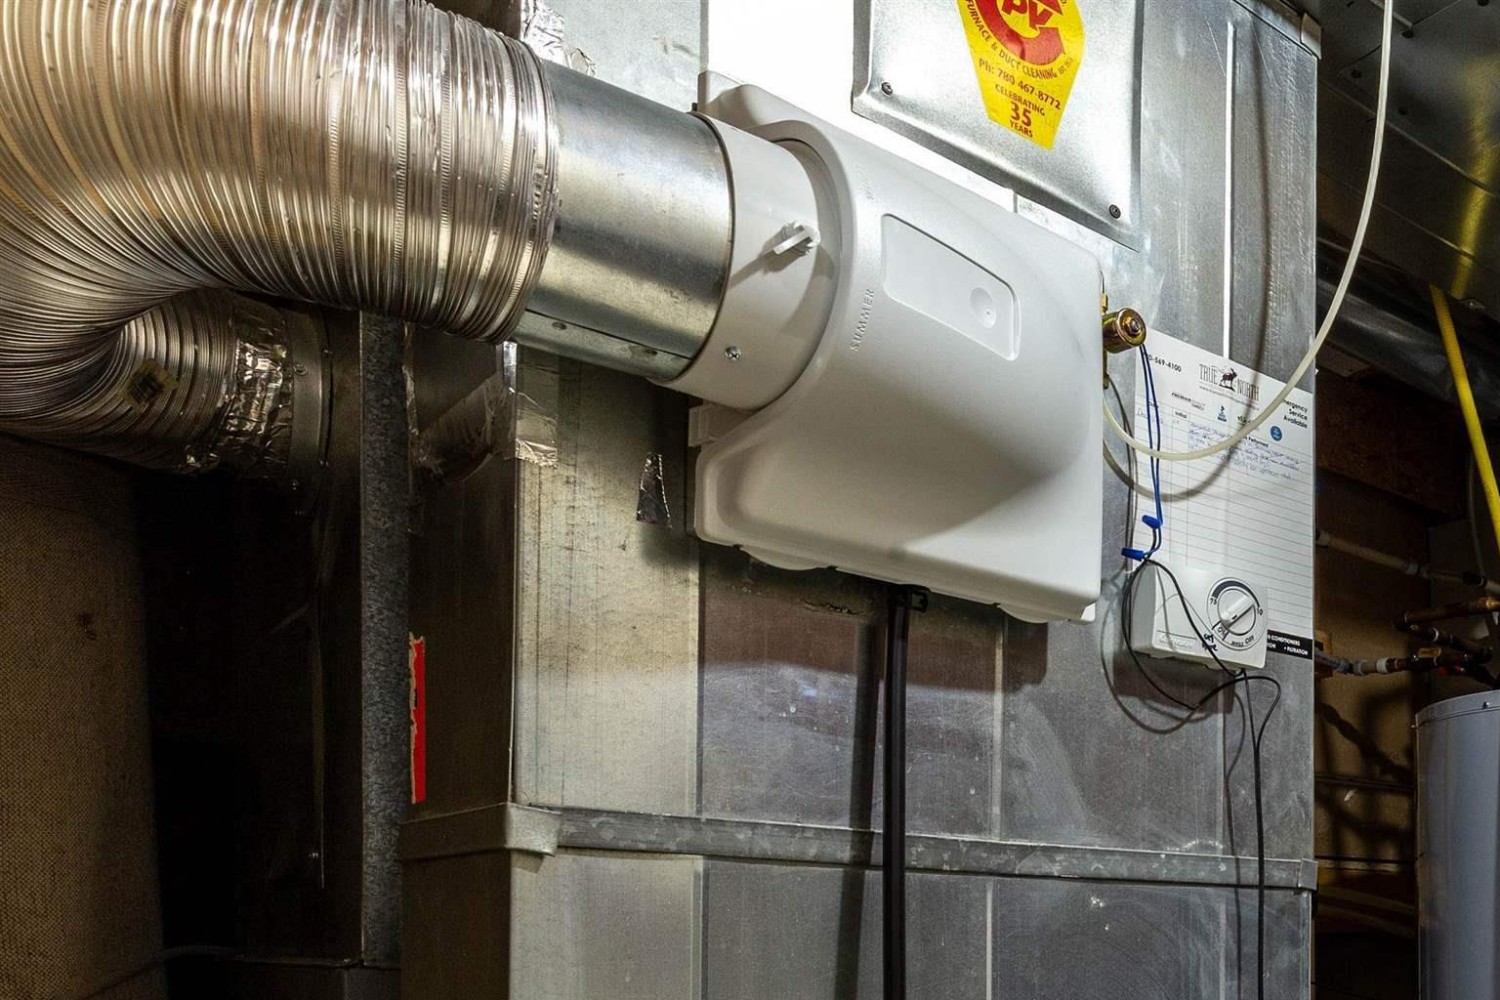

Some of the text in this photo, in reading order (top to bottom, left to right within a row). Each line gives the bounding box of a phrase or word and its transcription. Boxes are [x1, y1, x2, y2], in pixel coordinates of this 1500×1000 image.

[999, 49, 1020, 70] DUCT
[1021, 65, 1058, 80] CLEANING
[979, 57, 1061, 110] Ph: 780 467-8772
[995, 84, 1045, 116] CELEBRATING
[1010, 101, 1032, 127] 35
[1010, 119, 1033, 138] YEARS
[850, 289, 875, 352] SUMMER
[1200, 364, 1218, 385] TRUE
[1283, 415, 1308, 429] Available
[1288, 408, 1308, 421] Service
